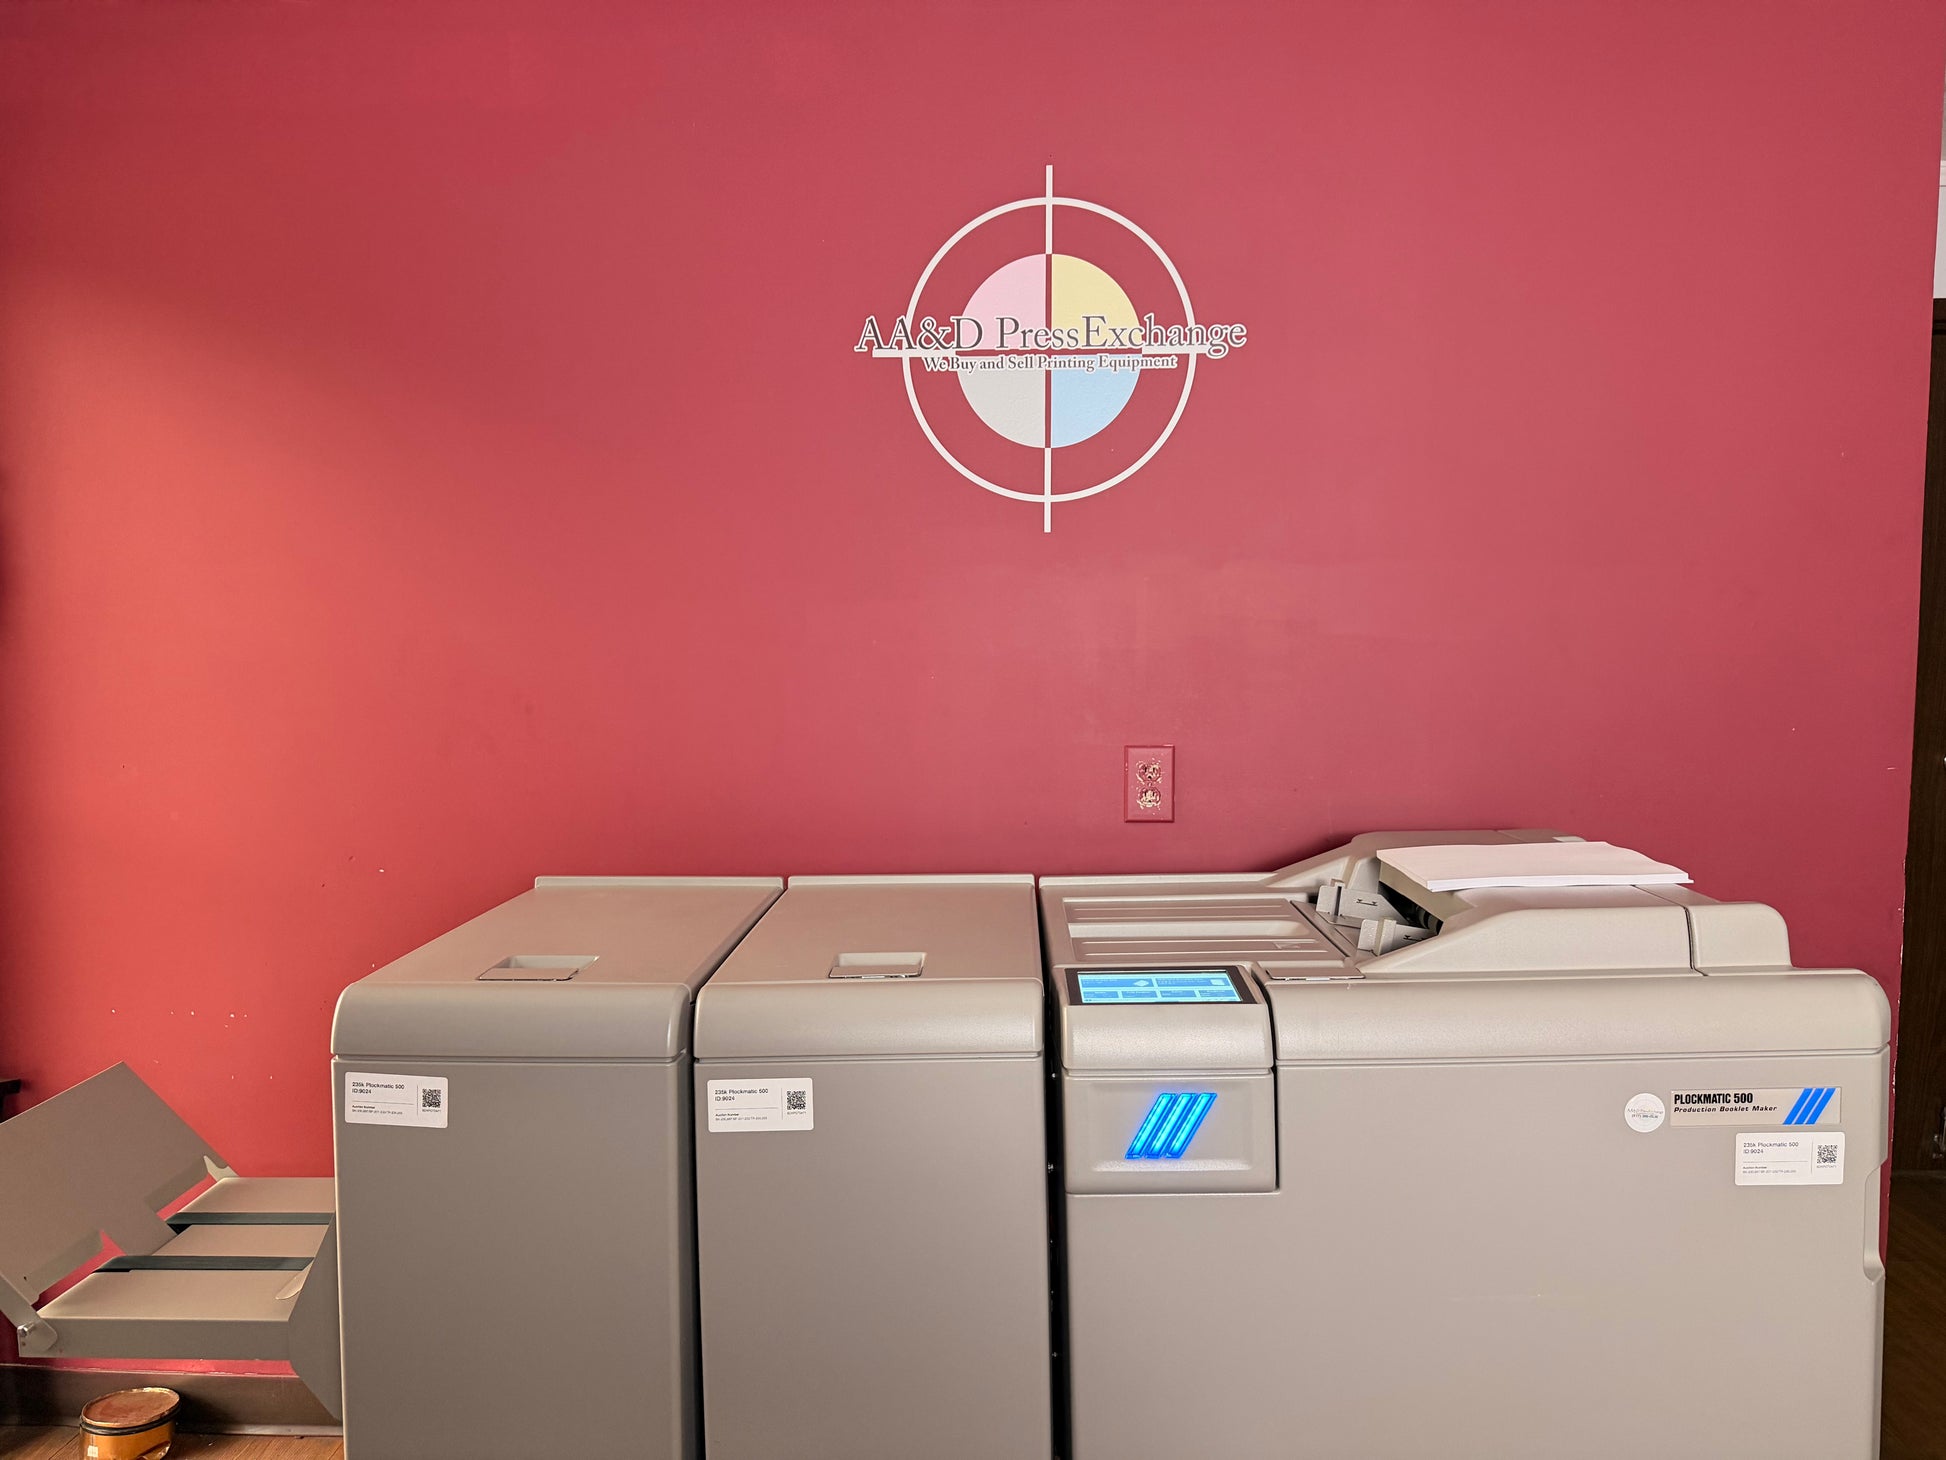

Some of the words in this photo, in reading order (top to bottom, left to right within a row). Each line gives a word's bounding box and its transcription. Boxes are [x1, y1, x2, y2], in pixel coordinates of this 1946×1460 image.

[854, 316, 984, 351] AA&D
[995, 314, 1247, 358] PressExchange
[924, 356, 947, 370] We
[950, 356, 976, 373] Buy
[980, 356, 1004, 370] and
[1008, 355, 1034, 369] Sell
[1038, 355, 1096, 372] Printing
[1099, 355, 1178, 372] Equipment
[1673, 1093, 1731, 1105] PLOCKMATIC
[1733, 1092, 1754, 1104] 500
